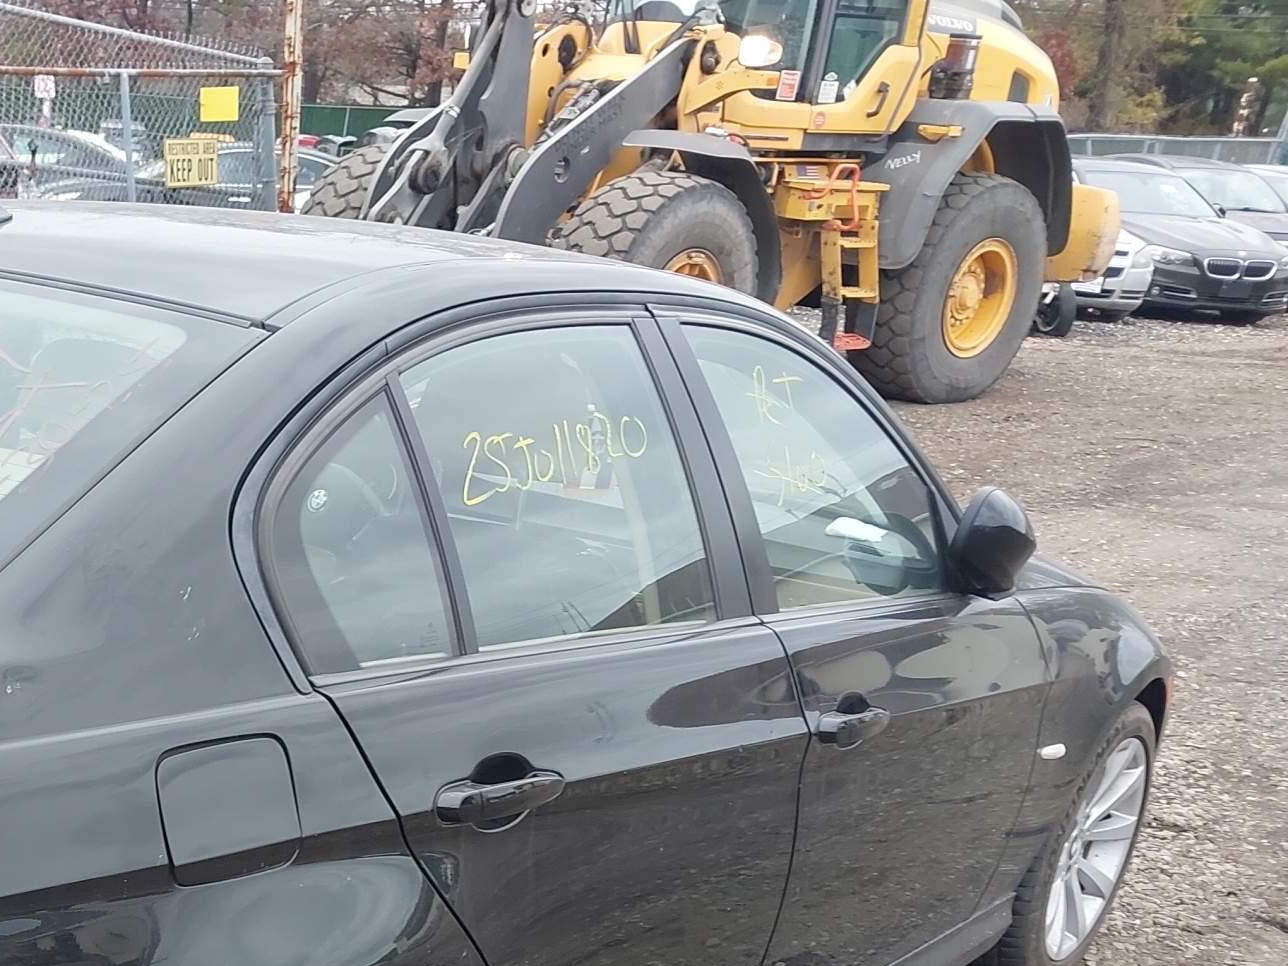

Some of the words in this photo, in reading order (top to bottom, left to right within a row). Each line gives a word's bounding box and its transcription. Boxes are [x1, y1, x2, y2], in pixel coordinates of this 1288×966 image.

[927, 14, 974, 32] VOLVO
[169, 158, 193, 183] KEEP
[197, 157, 215, 182] OUT
